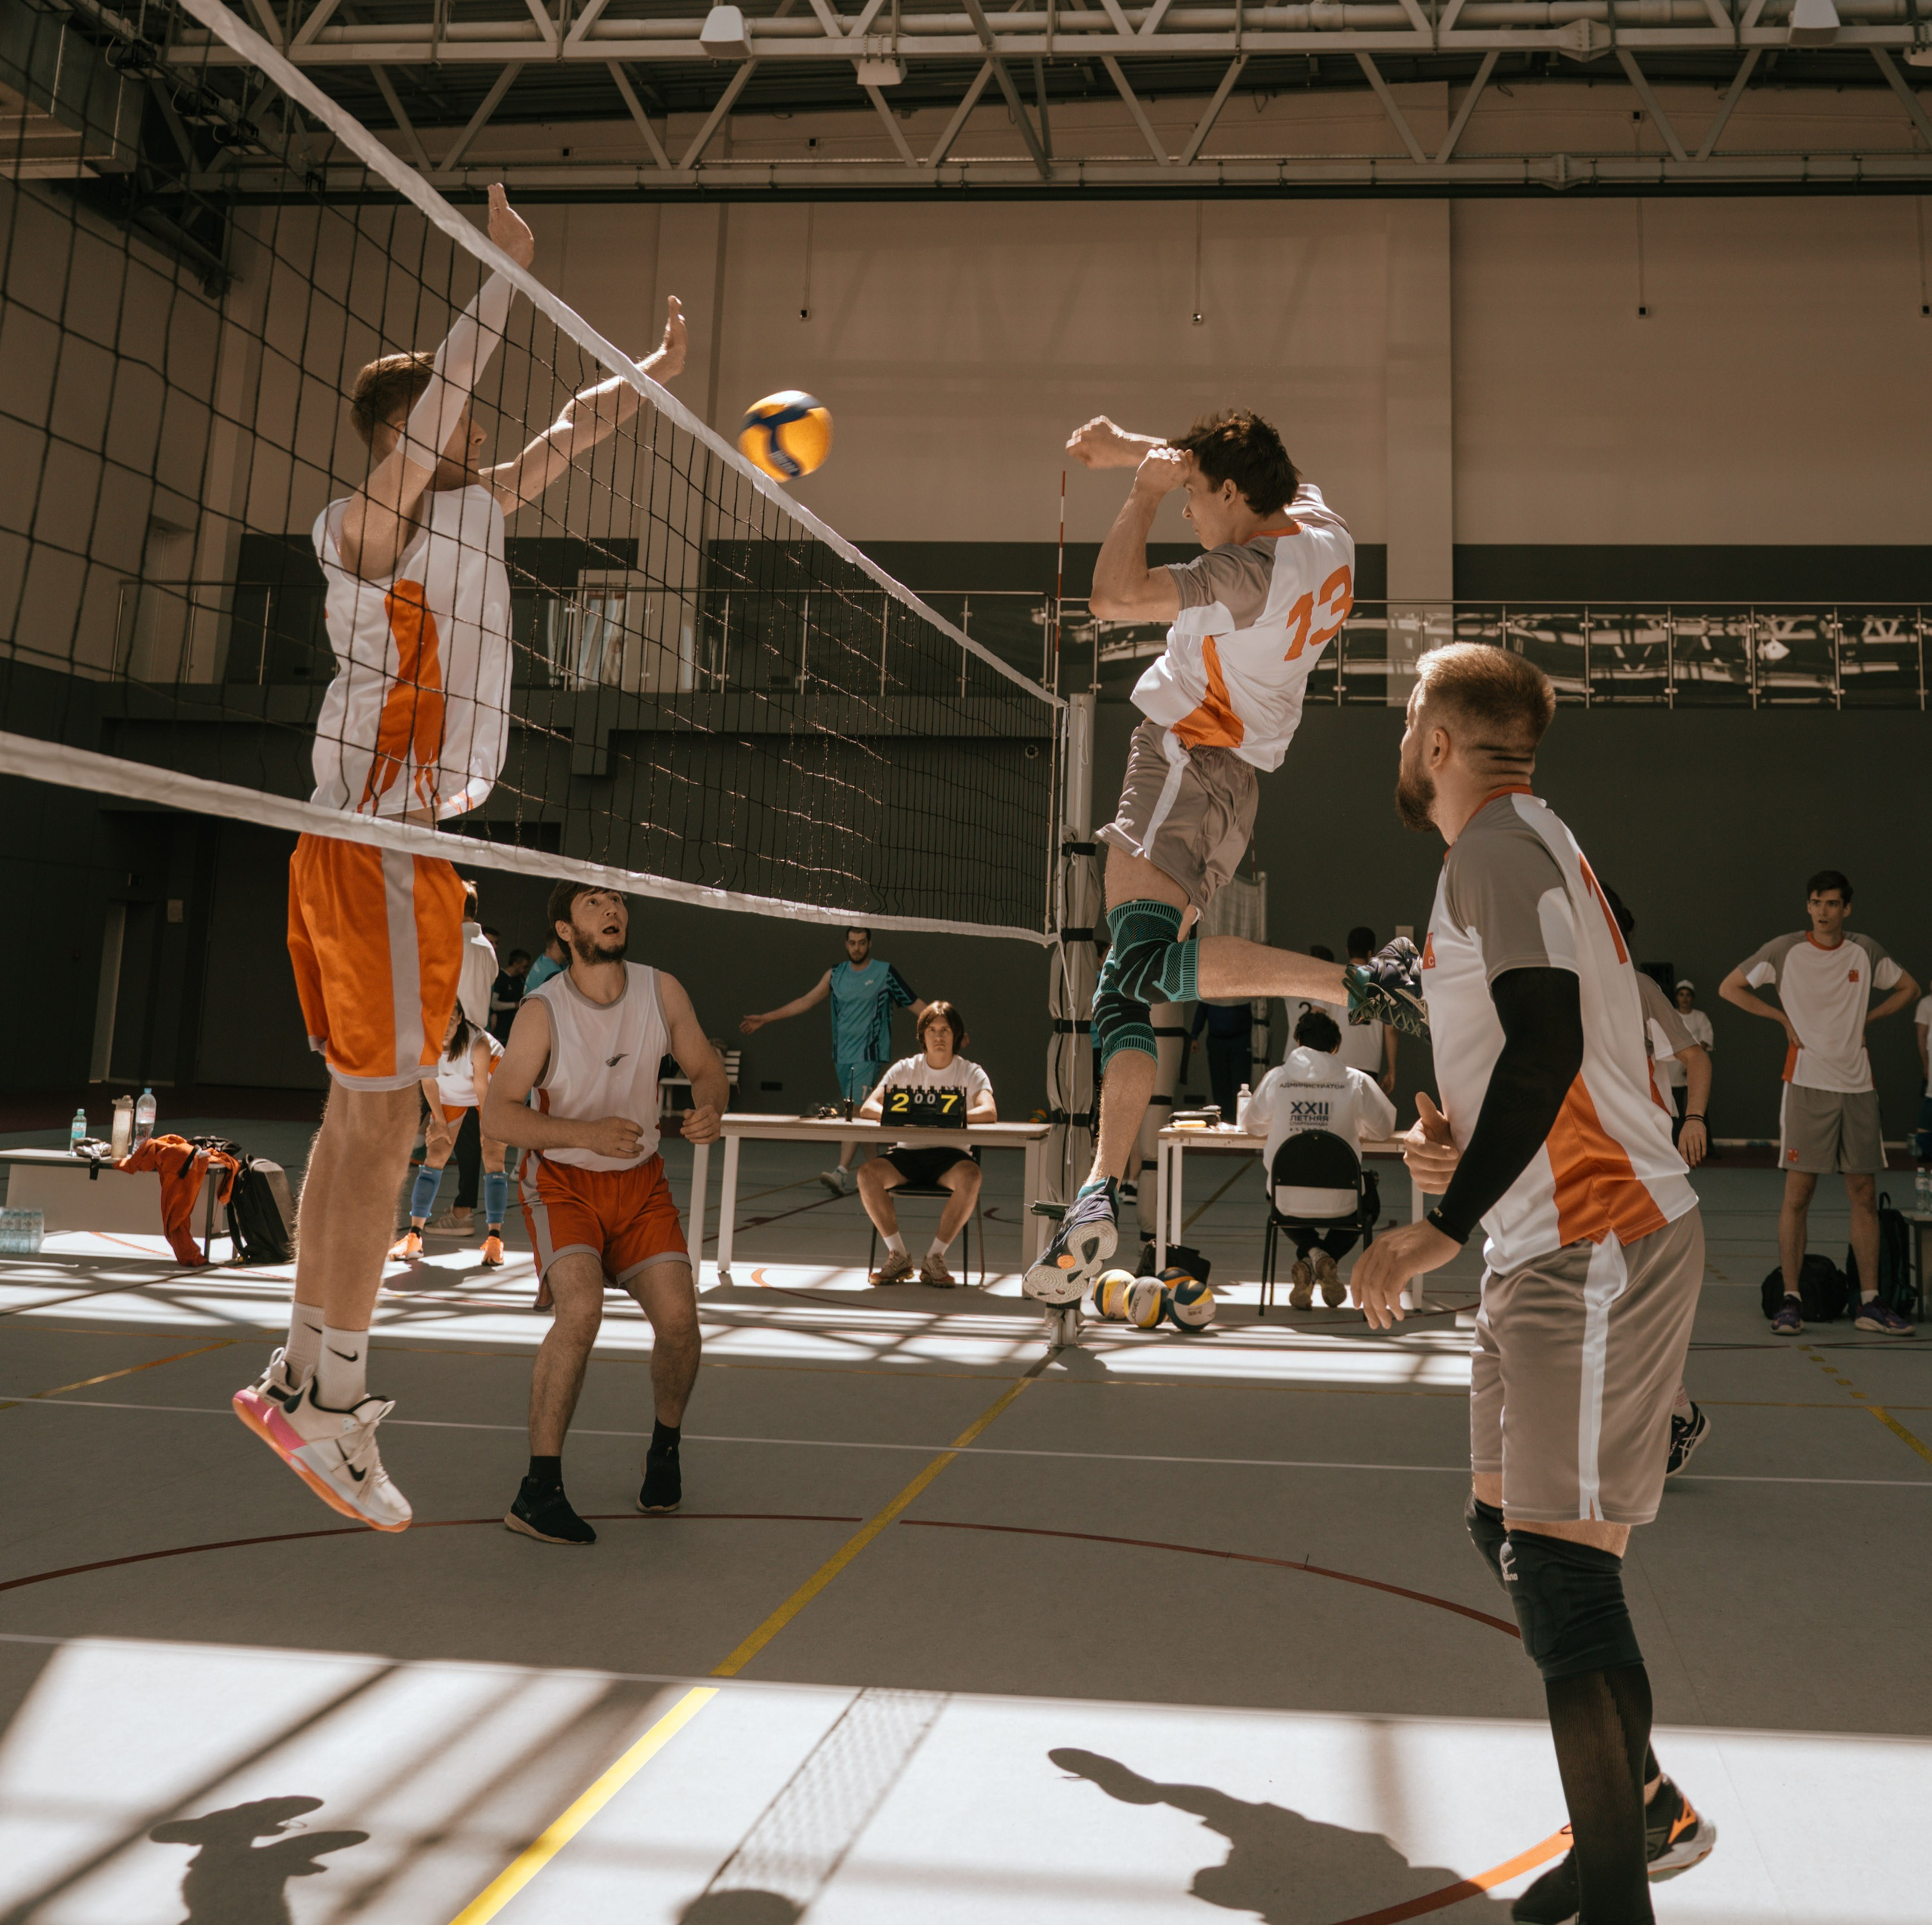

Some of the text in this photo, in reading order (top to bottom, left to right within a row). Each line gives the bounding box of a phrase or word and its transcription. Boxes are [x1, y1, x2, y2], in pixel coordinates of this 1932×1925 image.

[1284, 564, 1354, 661] 13
[891, 1093, 909, 1112] 2
[940, 1094, 958, 1113] 7
[1291, 1102, 1329, 1115] XXII
